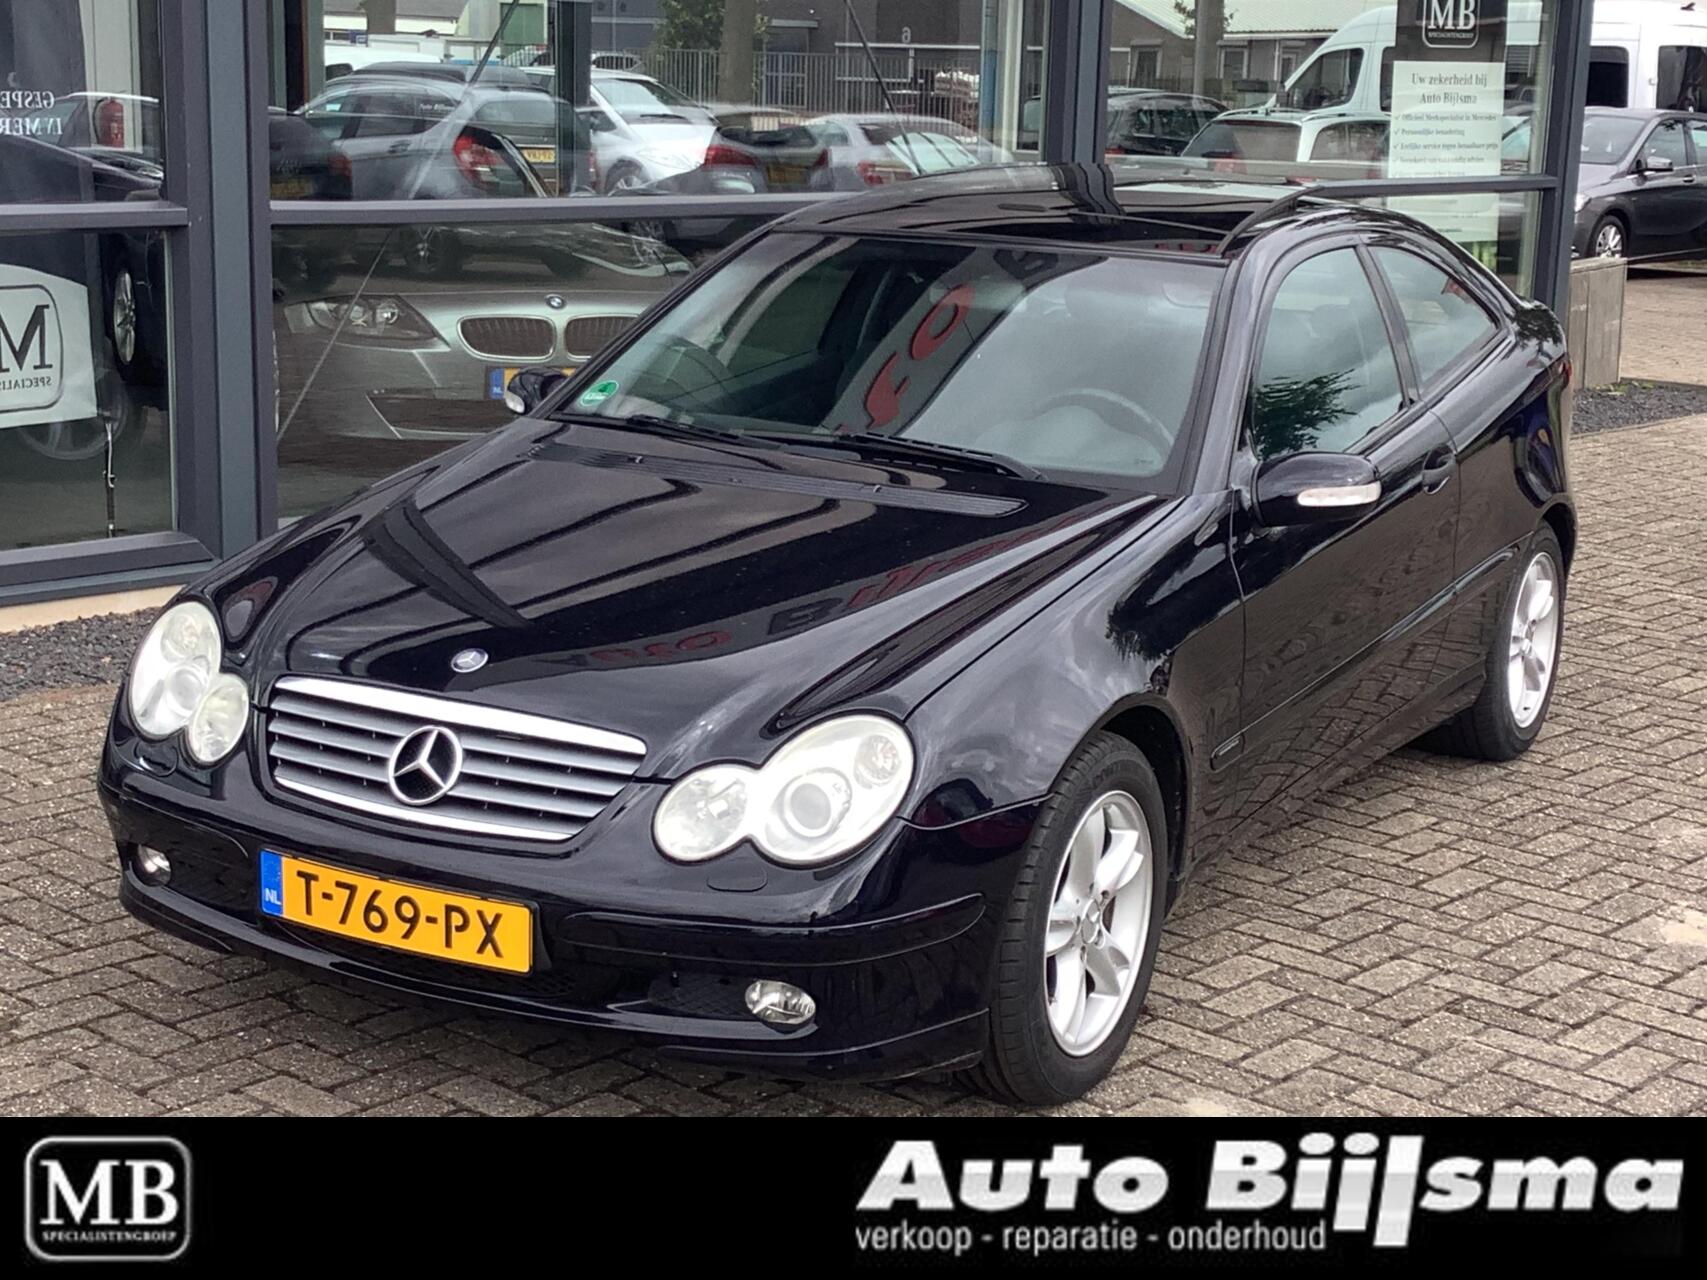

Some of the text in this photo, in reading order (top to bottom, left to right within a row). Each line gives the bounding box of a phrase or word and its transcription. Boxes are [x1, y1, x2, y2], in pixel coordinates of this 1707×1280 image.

[1427, 0, 1477, 30] MB
[1428, 73, 1473, 85] zekerheid
[1420, 91, 1477, 106] Auto Bijlsma
[265, 887, 281, 905] NL
[296, 869, 504, 959] T-769-PX
